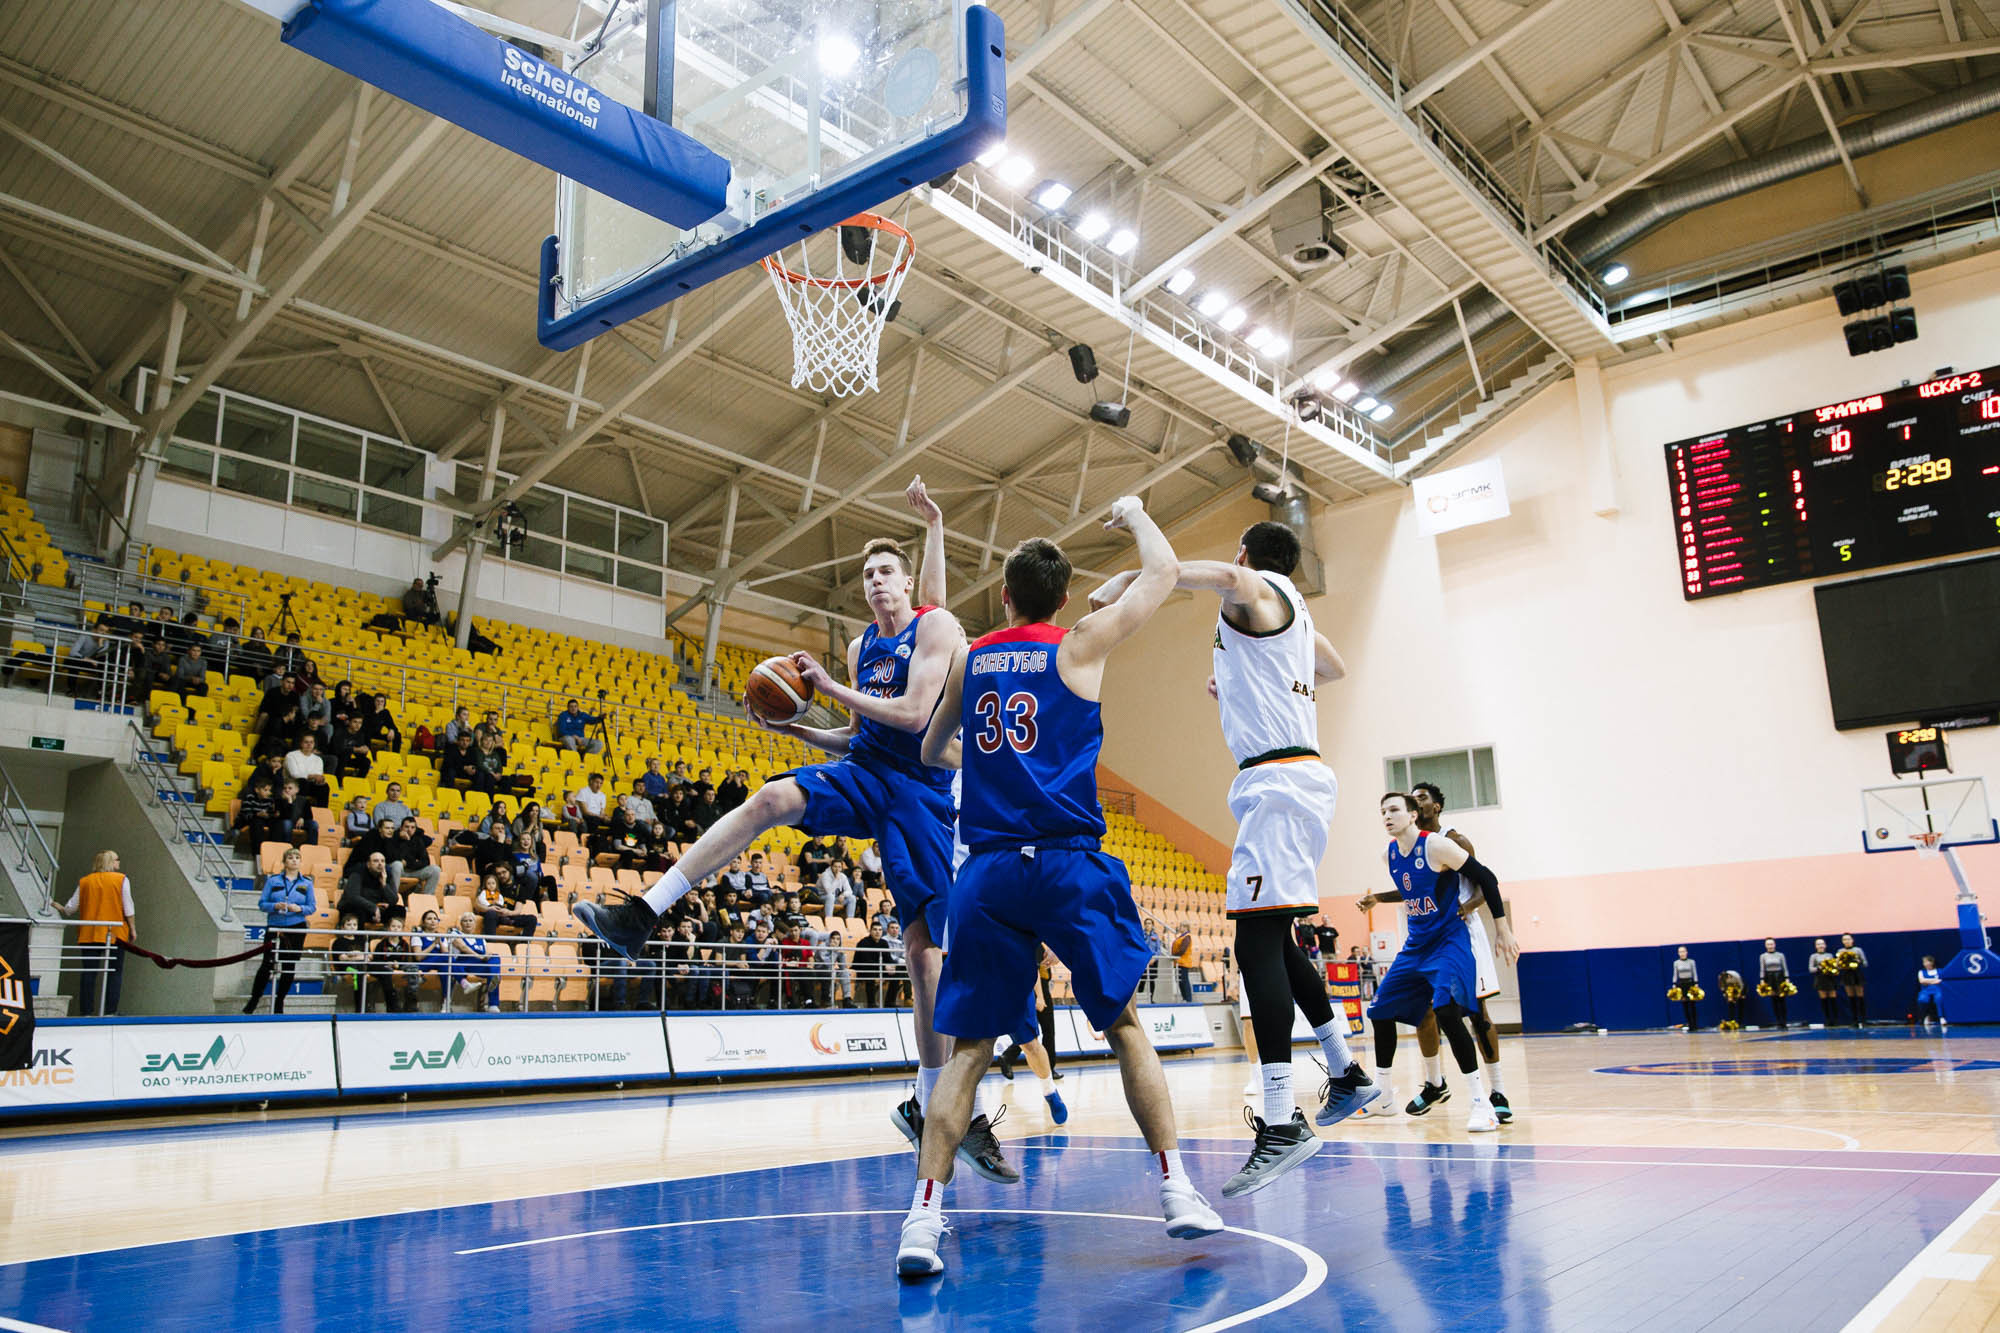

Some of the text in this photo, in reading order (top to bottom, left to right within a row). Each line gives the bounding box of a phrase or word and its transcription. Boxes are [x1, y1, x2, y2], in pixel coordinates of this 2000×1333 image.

[504, 48, 601, 113] Schelde
[501, 69, 598, 130] International
[1919, 373, 1982, 398] ЦСКА-2
[1961, 389, 1994, 404] СЧЕТ
[1982, 396, 2000, 418] 10
[1813, 424, 1842, 438] СЧЕТ
[1831, 430, 1851, 452] 10
[1903, 425, 1911, 440] 1
[1890, 453, 1931, 469] ВРЕМЯ
[1840, 545, 1852, 561] 5
[870, 656, 895, 684] 30
[972, 650, 1048, 676] СИНЕГУБОВ
[975, 691, 1038, 753] 33
[1246, 875, 1263, 902] 7
[1403, 872, 1412, 891] 6
[258, 928, 266, 939] 2
[1968, 953, 1984, 974] S
[848, 1038, 886, 1051] УГМК
[487, 1055, 512, 1066] ОАО
[142, 1077, 171, 1088] ОАО
